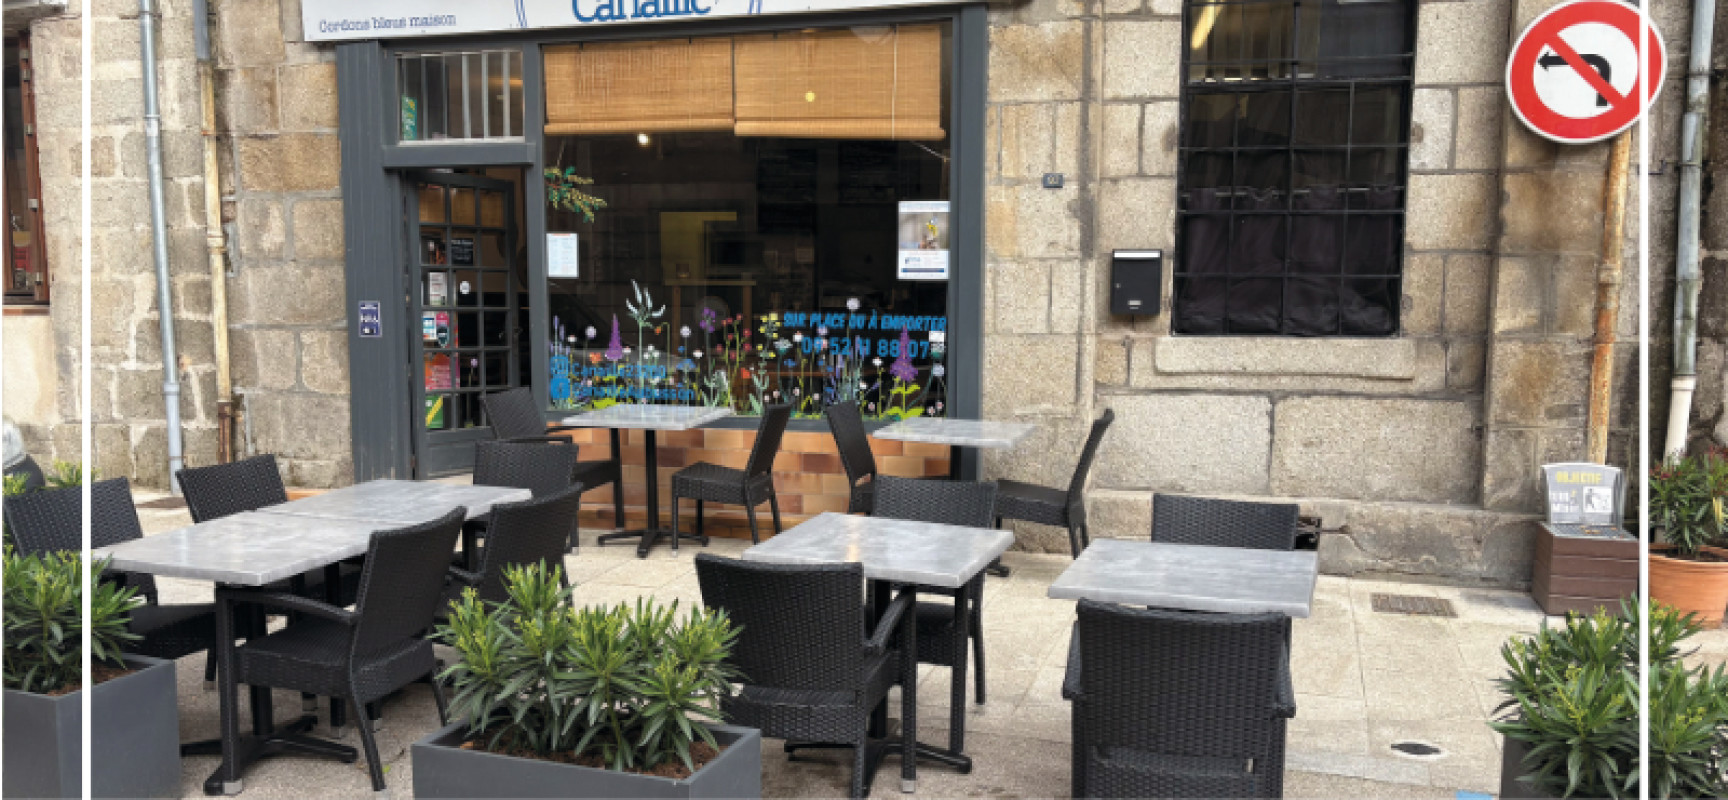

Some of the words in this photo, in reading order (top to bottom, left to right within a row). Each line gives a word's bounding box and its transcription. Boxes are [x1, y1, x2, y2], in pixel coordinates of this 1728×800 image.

[372, 16, 406, 29] bleus
[409, 13, 457, 27] maison
[783, 311, 807, 328] SUR
[810, 311, 846, 329] PLACE
[849, 312, 866, 330] OU
[868, 308, 878, 330] À
[881, 314, 947, 332] EMPORTER
[801, 336, 824, 355] 09
[829, 336, 852, 356] 52
[877, 338, 901, 358] 88
[907, 340, 930, 359] 07
[1556, 470, 1603, 485] OBJECTIF
